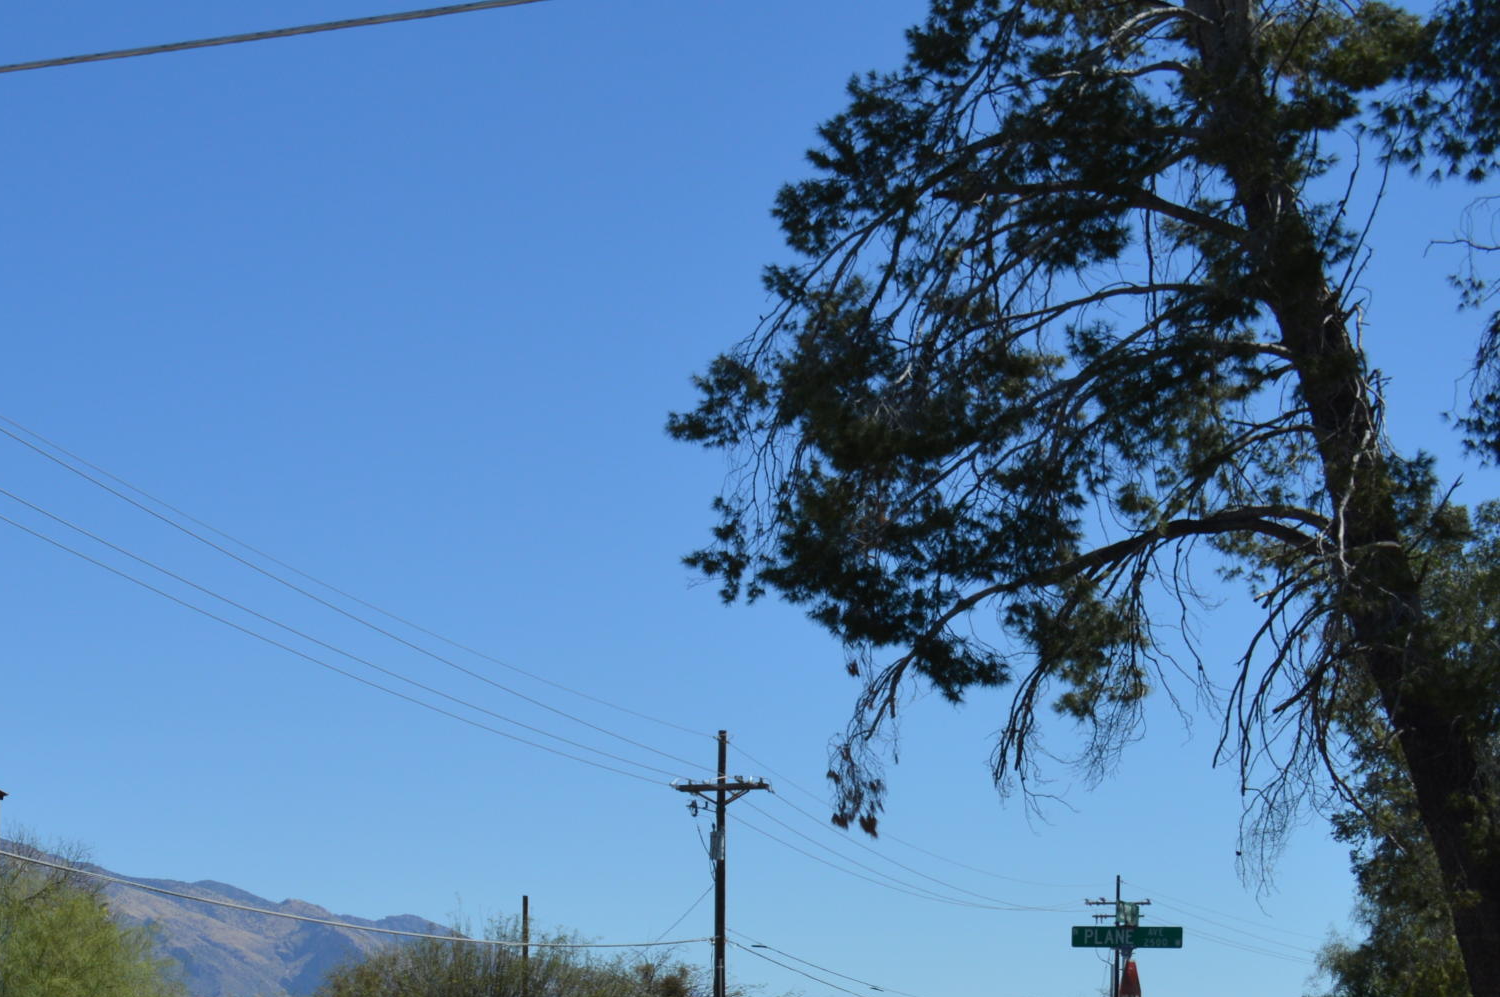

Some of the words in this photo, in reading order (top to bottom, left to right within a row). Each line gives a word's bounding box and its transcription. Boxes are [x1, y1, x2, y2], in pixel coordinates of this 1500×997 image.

[1084, 928, 1134, 945] PLANE
[1148, 928, 1164, 936] AVE
[1143, 938, 1168, 946] 2500
